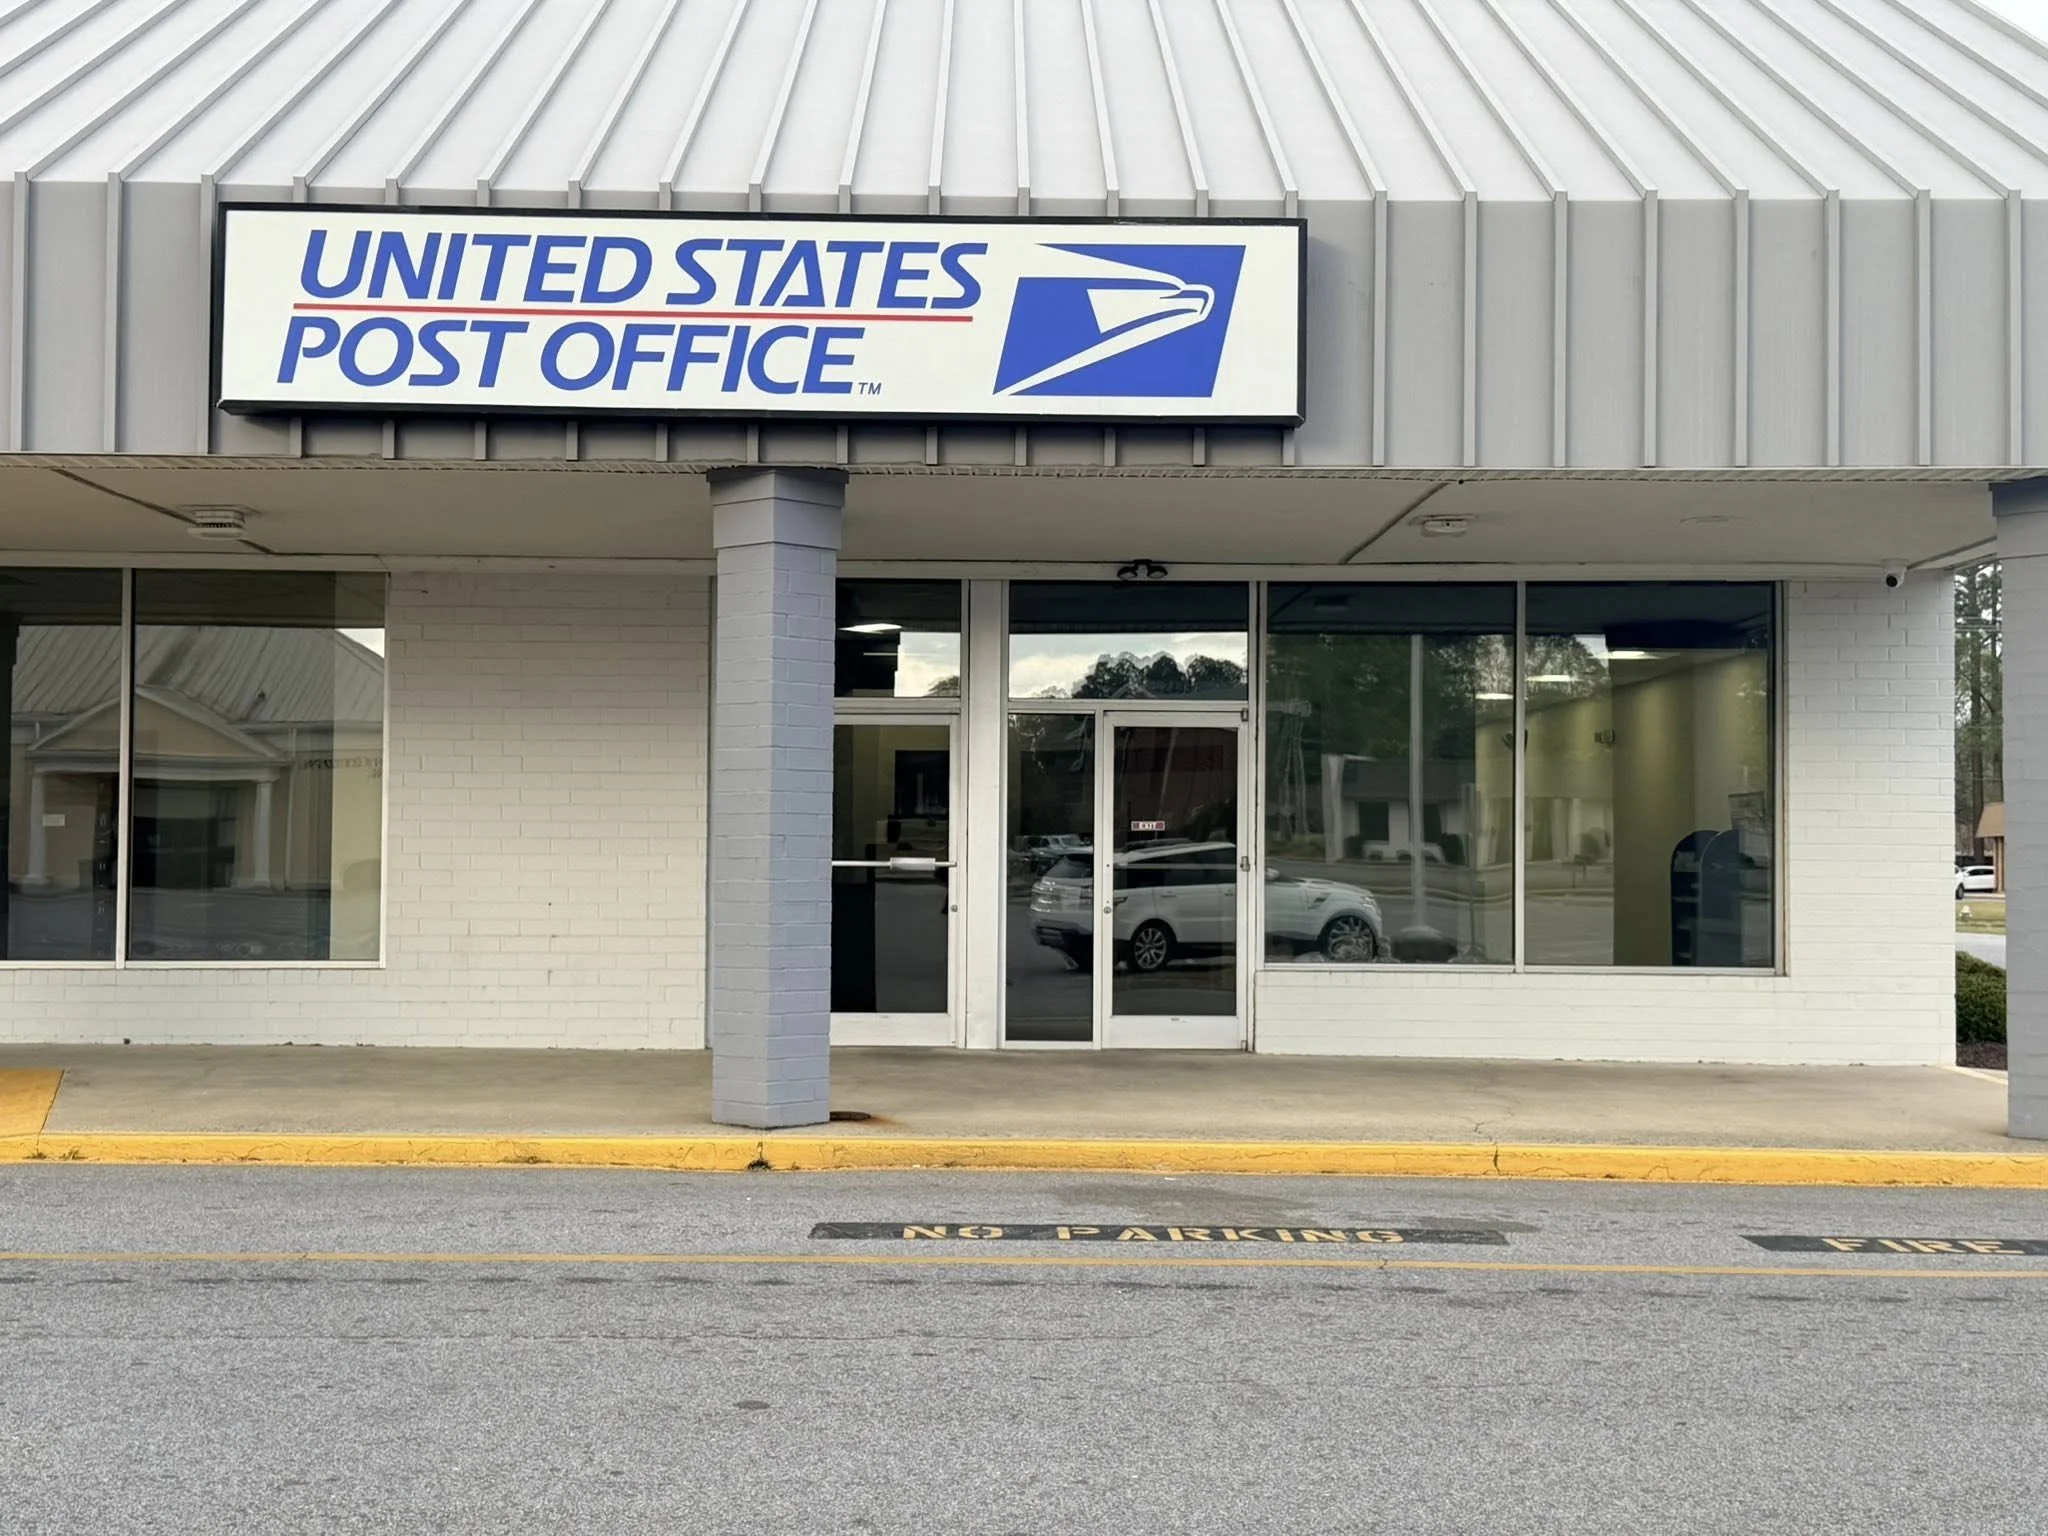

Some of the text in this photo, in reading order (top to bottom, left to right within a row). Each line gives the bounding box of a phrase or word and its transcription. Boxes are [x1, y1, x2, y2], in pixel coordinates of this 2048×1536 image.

[301, 230, 988, 309] UNITED STATES
[277, 316, 529, 388] POST
[541, 323, 865, 395] OFFICE
[903, 1225, 1404, 1243] NO PARKING
[1821, 1238, 2025, 1254] FIRE
